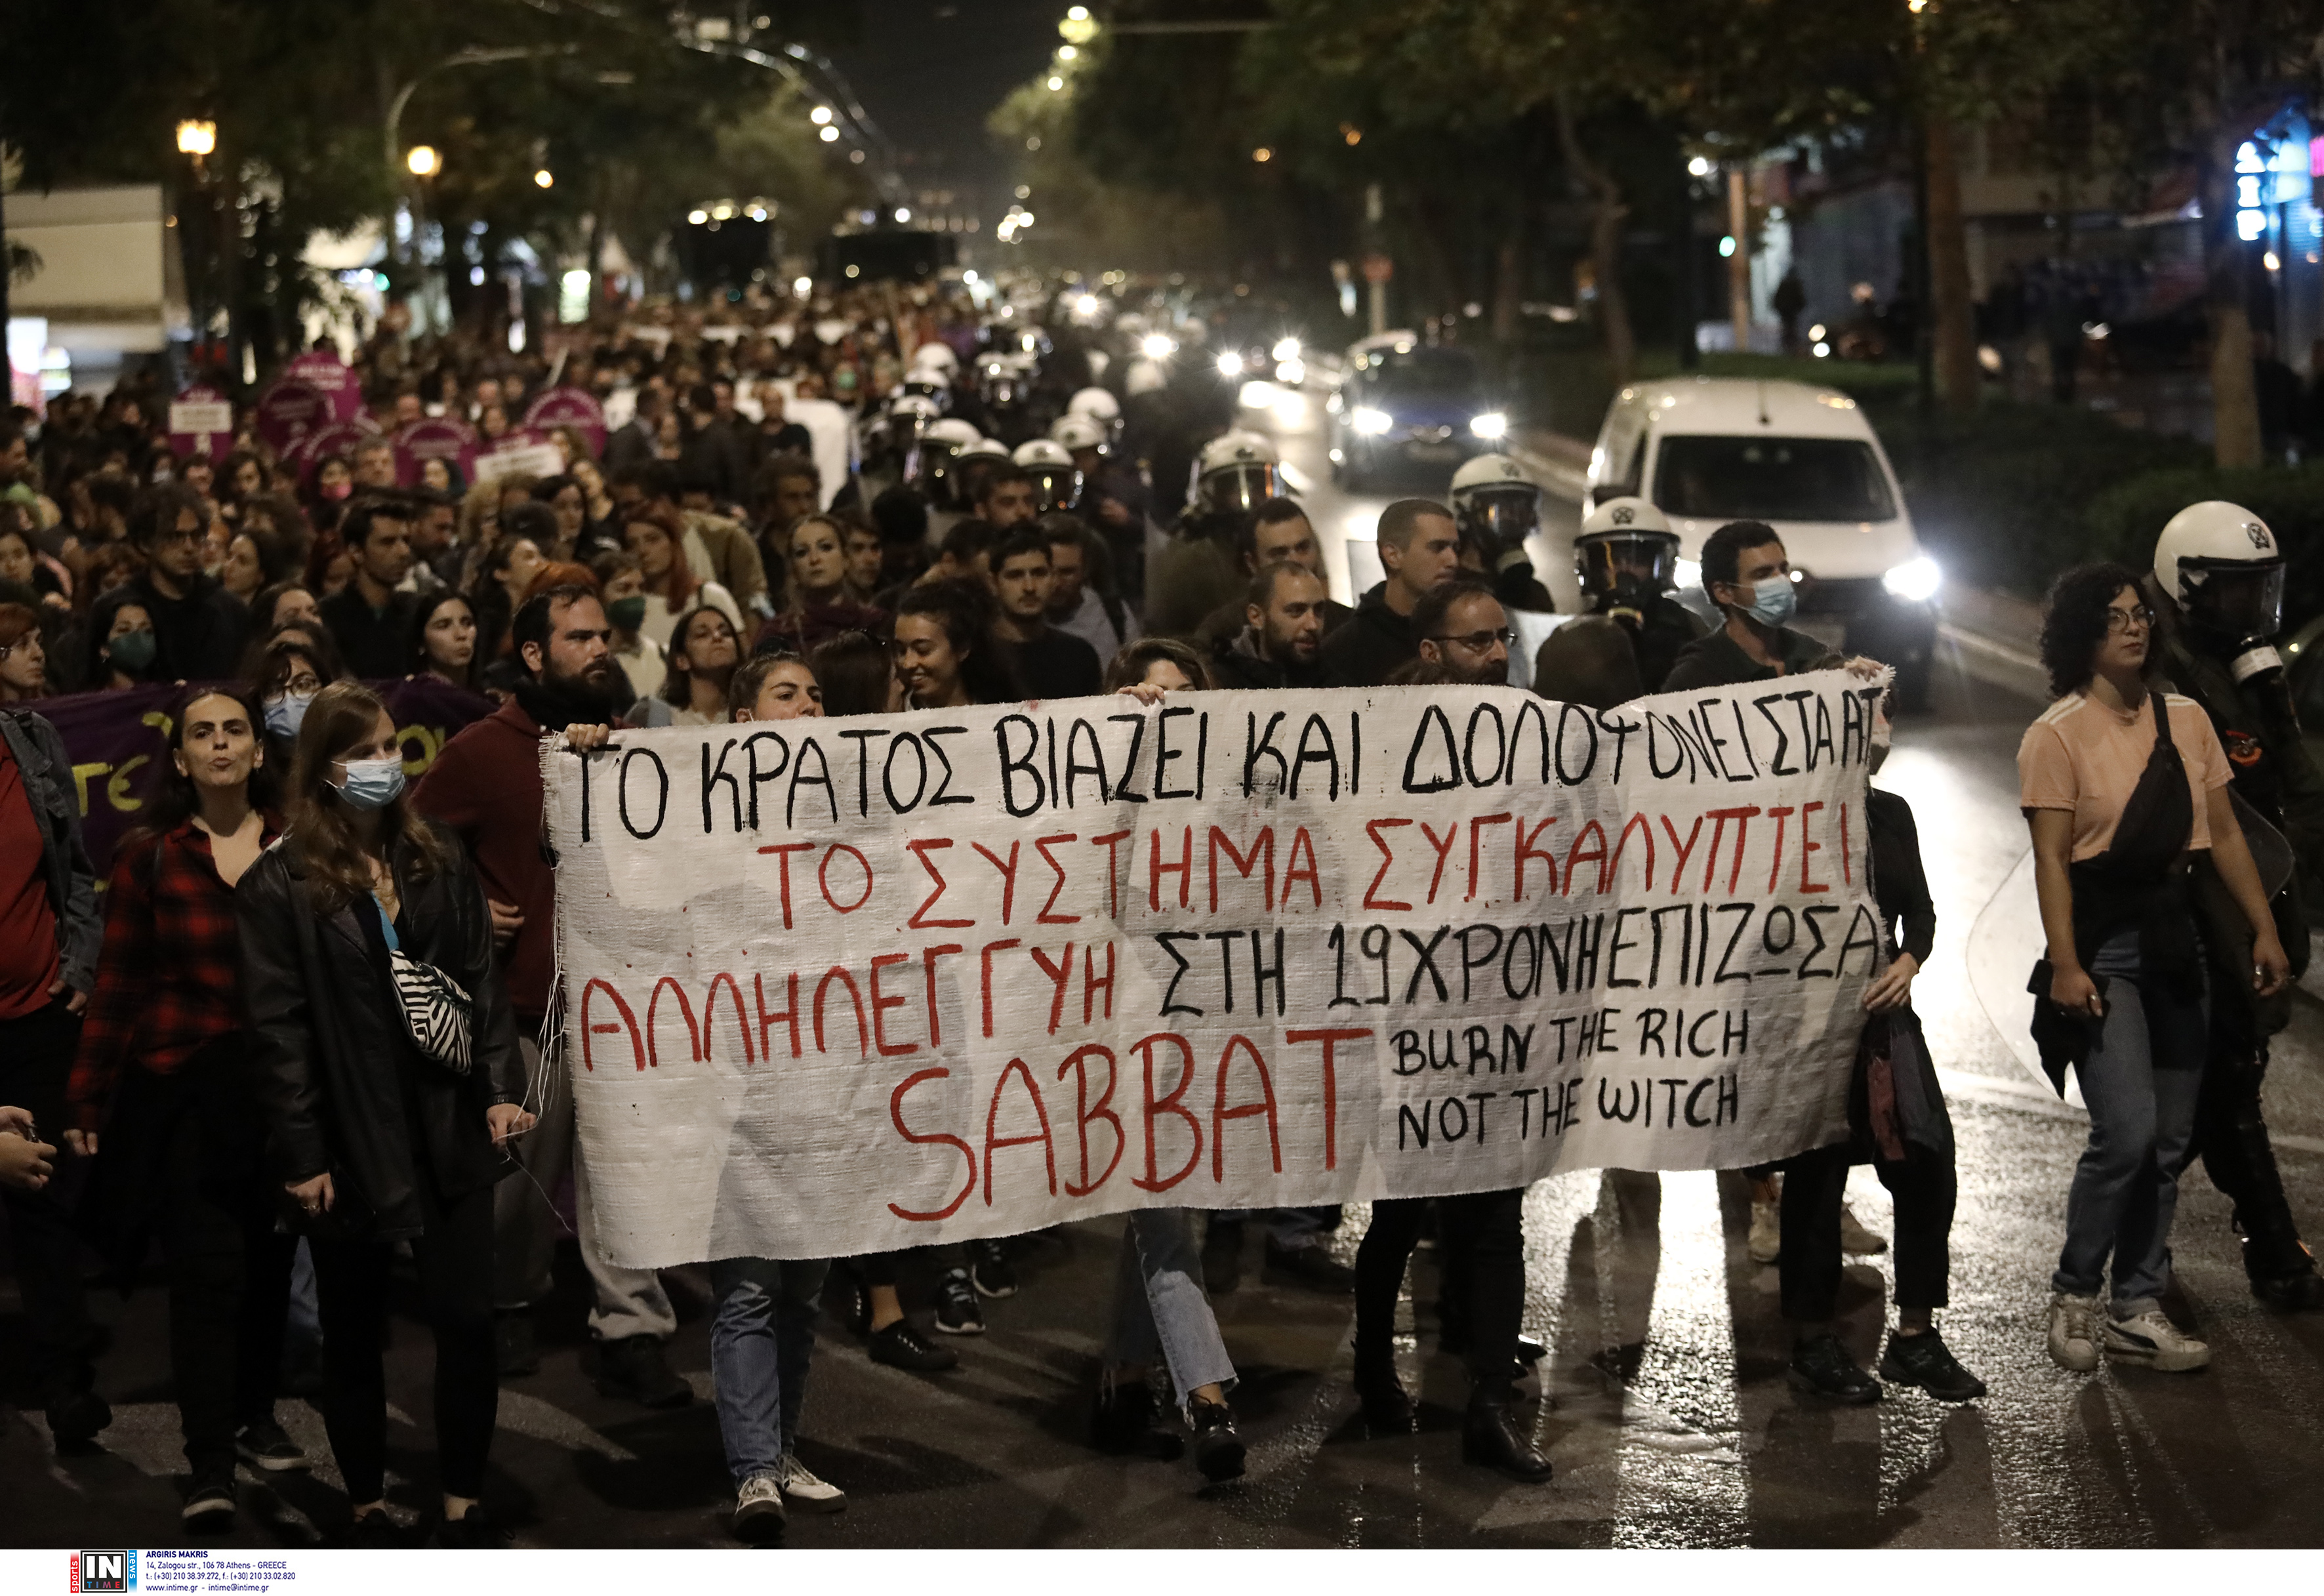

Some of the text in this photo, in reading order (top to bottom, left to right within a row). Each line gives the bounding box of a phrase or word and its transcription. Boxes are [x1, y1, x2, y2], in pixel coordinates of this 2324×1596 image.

[556, 743, 669, 843] ΤΟ
[701, 726, 975, 833] ΚΡΑΤΟΣ
[994, 706, 1208, 817] ΒΙΑΖΕΙ
[1243, 711, 1360, 802] ΚΑΙ
[757, 800, 1850, 930] ΤΟ ΣΥΣΤΗΜΑ ΣΥΓΚΑΛΥΠΤΕΙ
[581, 938, 1115, 1072] ΑΛΛΗΛΕΓΓΥΗ
[1154, 926, 1286, 1018] ΣΤΗ
[1389, 1007, 1749, 1077] BURN THE RICH
[887, 1028, 1374, 1222] SABBAT
[1398, 1073, 1739, 1153] NOT THE WITCH
